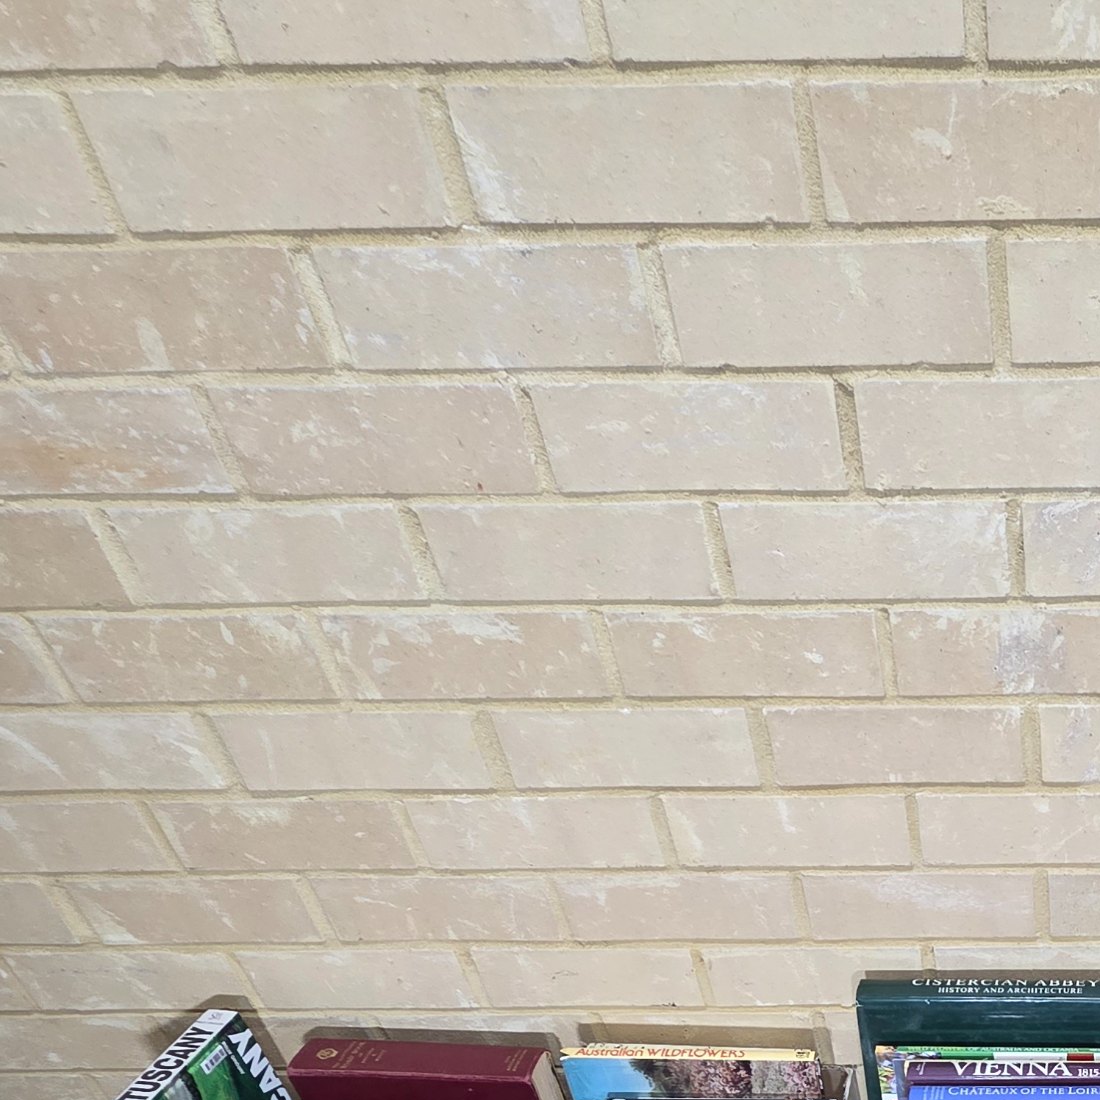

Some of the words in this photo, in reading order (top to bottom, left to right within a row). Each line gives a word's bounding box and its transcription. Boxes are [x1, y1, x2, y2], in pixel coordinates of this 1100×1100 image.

[912, 978, 1027, 986] CISTERCIAN
[575, 1048, 643, 1057] Australian
[647, 1049, 745, 1058] WILDFLOWERS
[951, 1062, 1073, 1076] VIENNA
[1019, 1087, 1037, 1095] OF
[1040, 1087, 1064, 1095] THE
